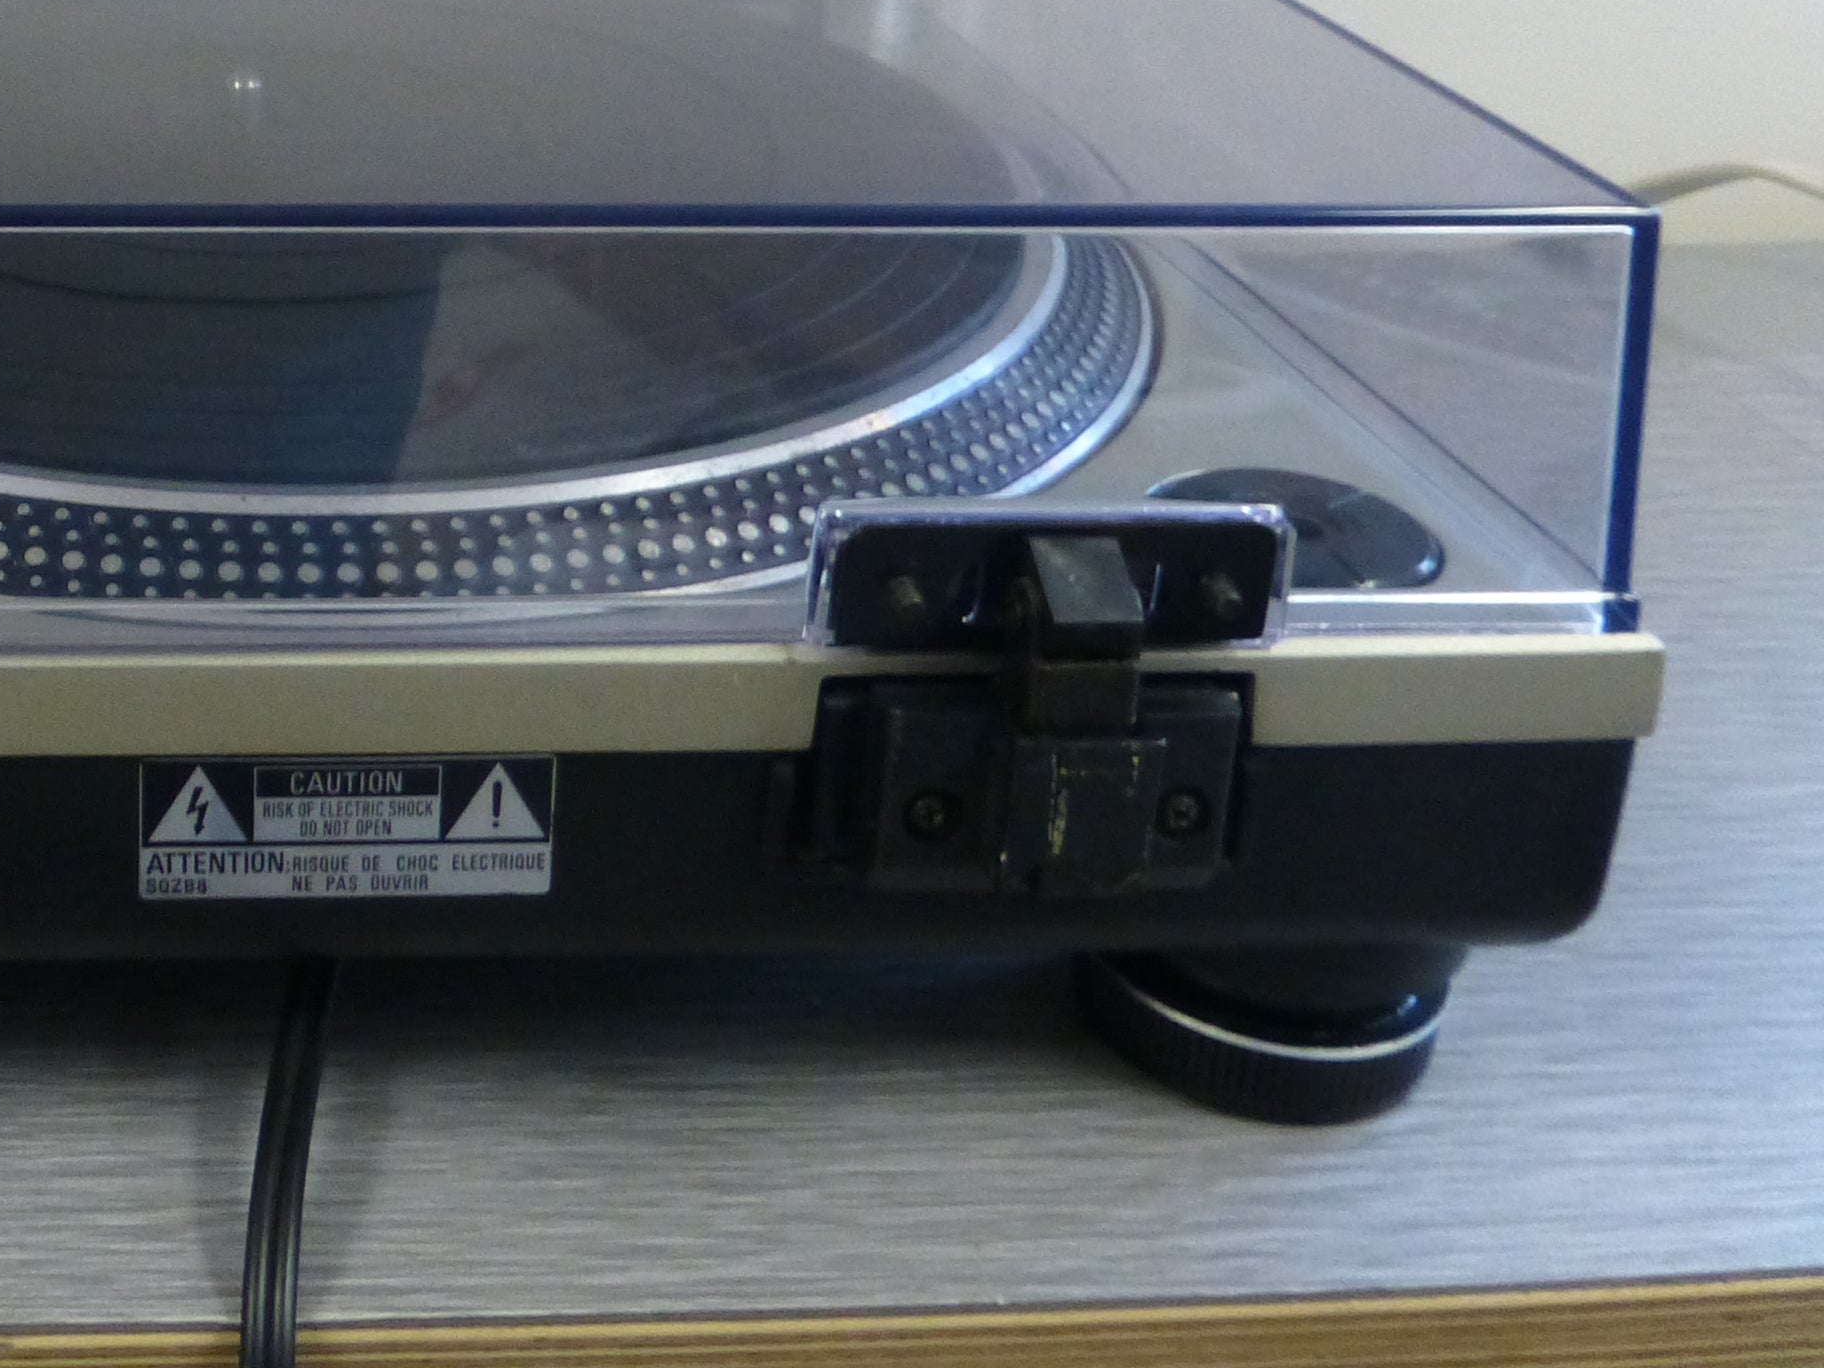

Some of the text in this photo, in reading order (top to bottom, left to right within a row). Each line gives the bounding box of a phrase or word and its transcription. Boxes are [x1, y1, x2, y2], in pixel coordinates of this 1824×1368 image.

[290, 770, 404, 795] CAUTION
[262, 799, 434, 819] RISK OF ELECTRIC SHOCK
[299, 819, 393, 838] DO NOT OPEN
[292, 853, 546, 873] RISQUE DE CHOC ELECTRIQUE
[291, 874, 429, 893] NE PAS OUVRIR
